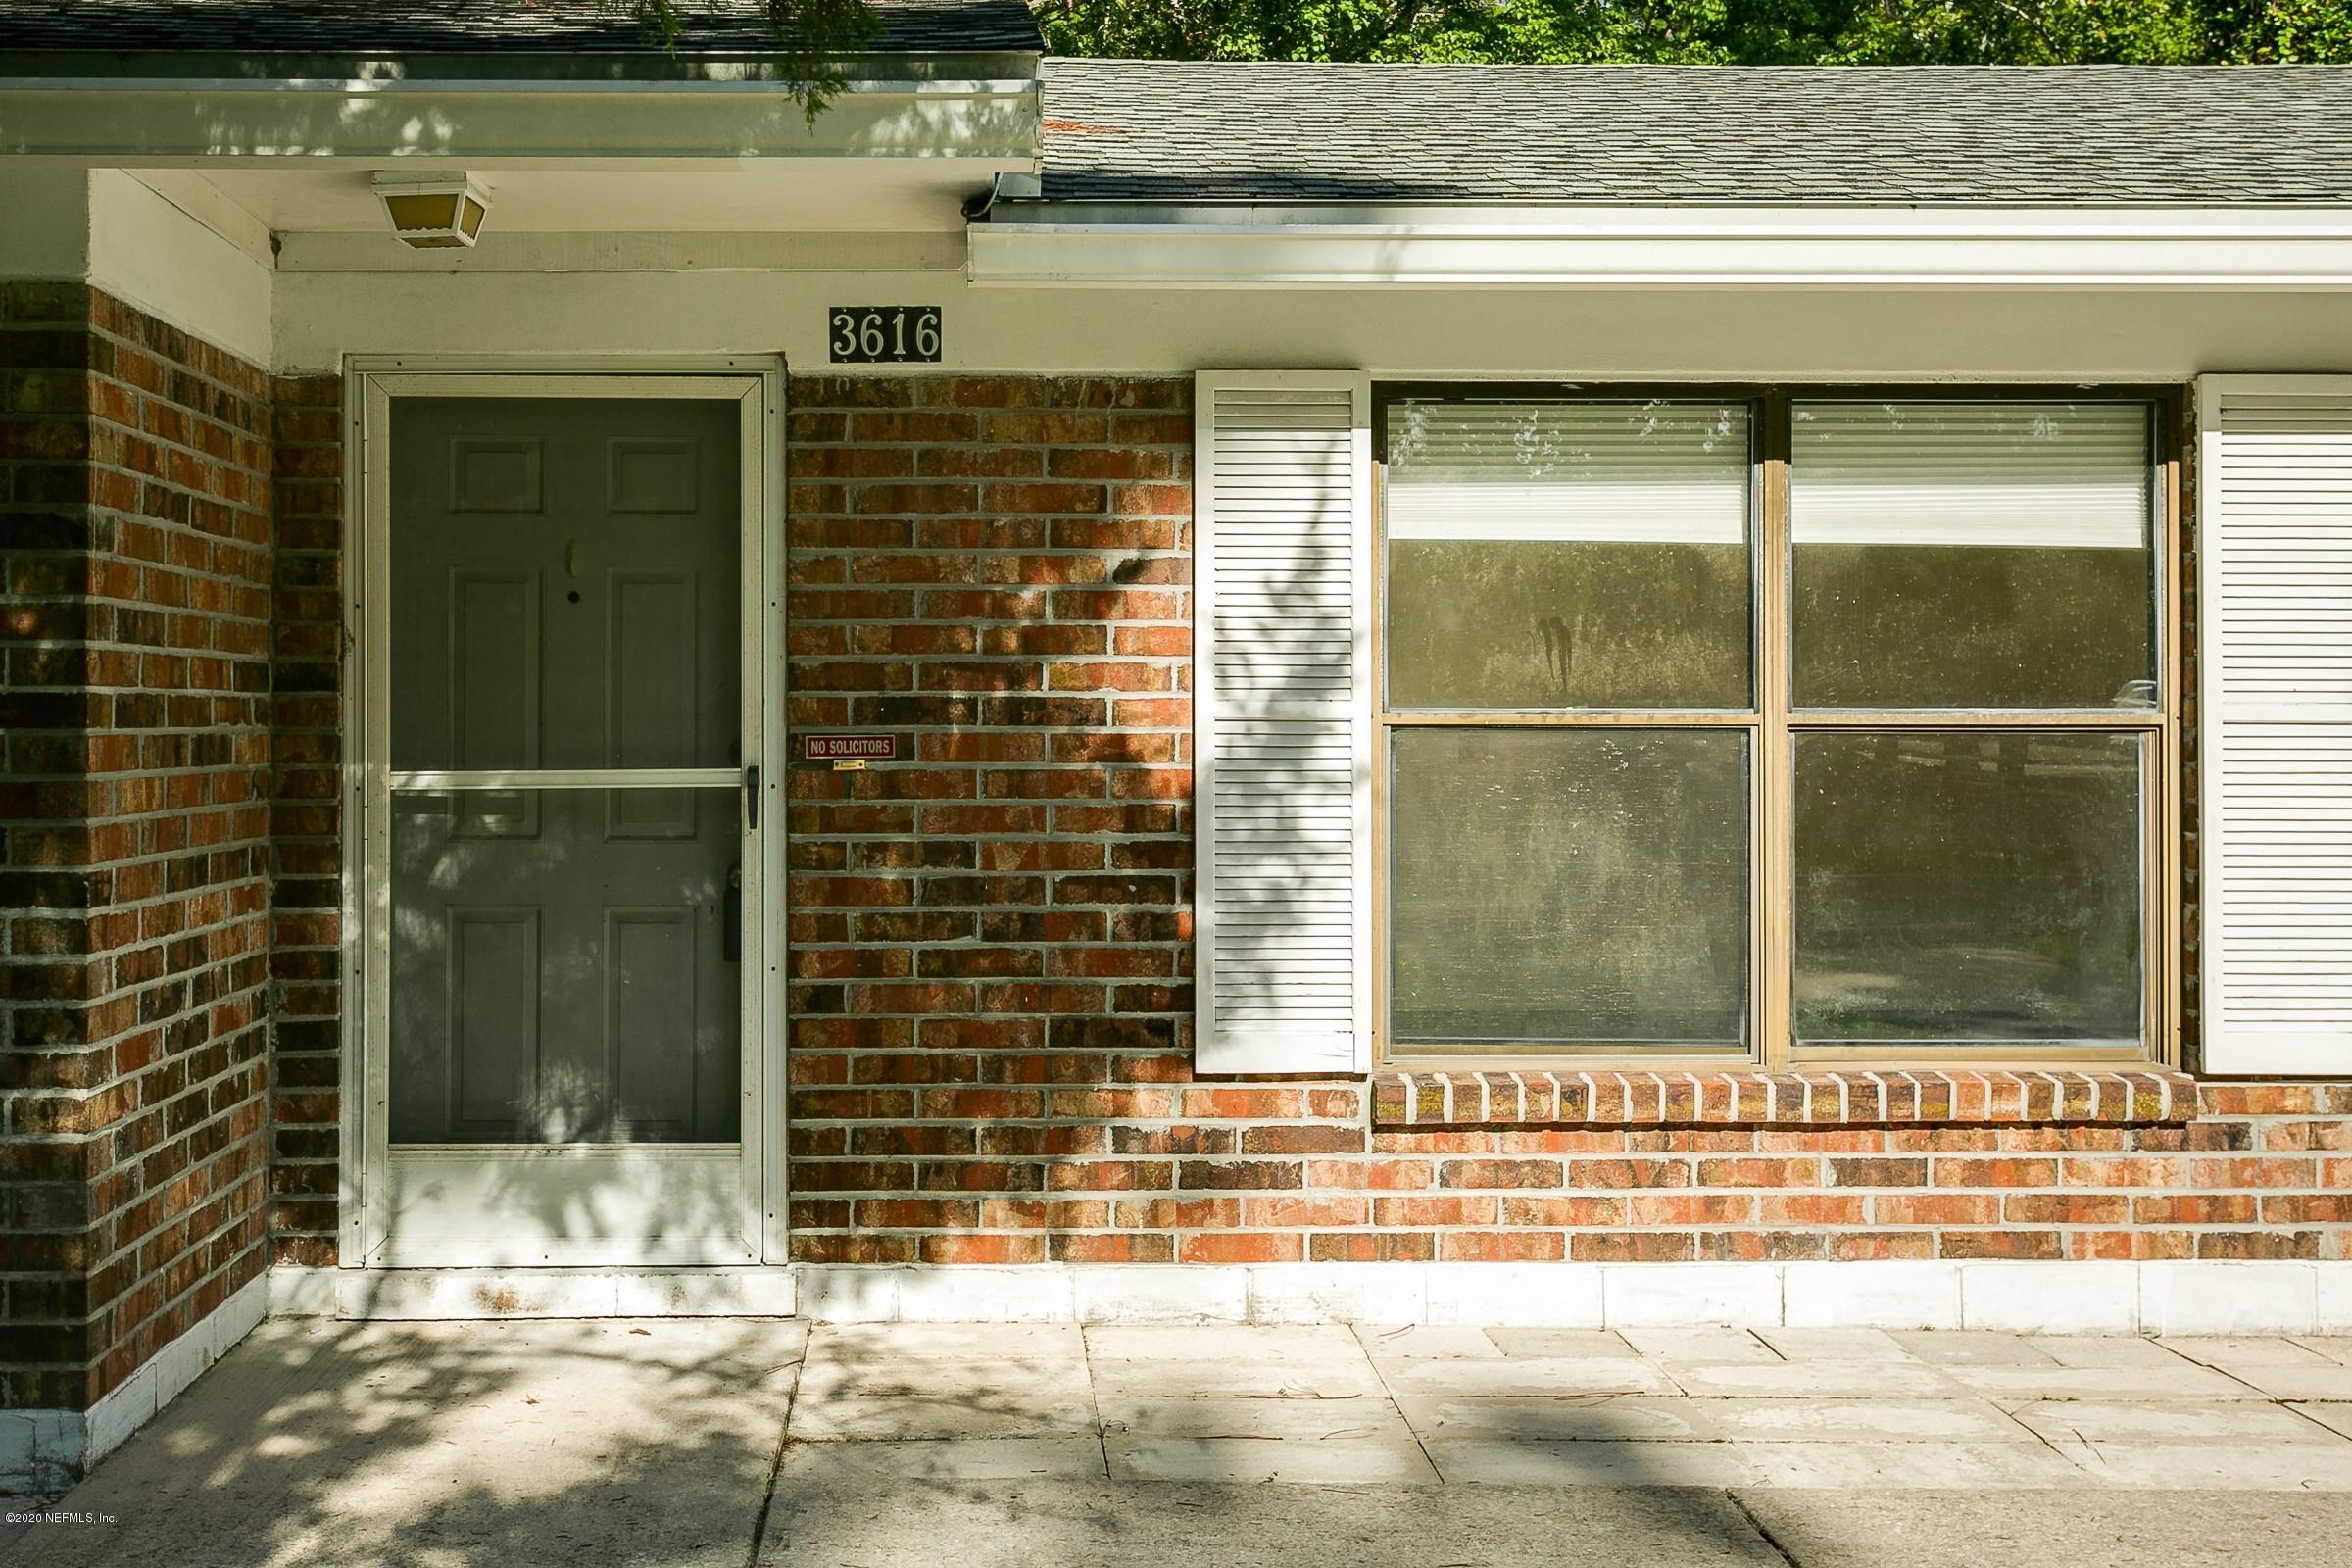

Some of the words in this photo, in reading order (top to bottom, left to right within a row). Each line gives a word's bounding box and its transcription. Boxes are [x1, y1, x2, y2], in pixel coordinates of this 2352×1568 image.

[833, 313, 940, 357] 3616
[810, 740, 826, 754] NO
[829, 739, 890, 754] SOLICITORS
